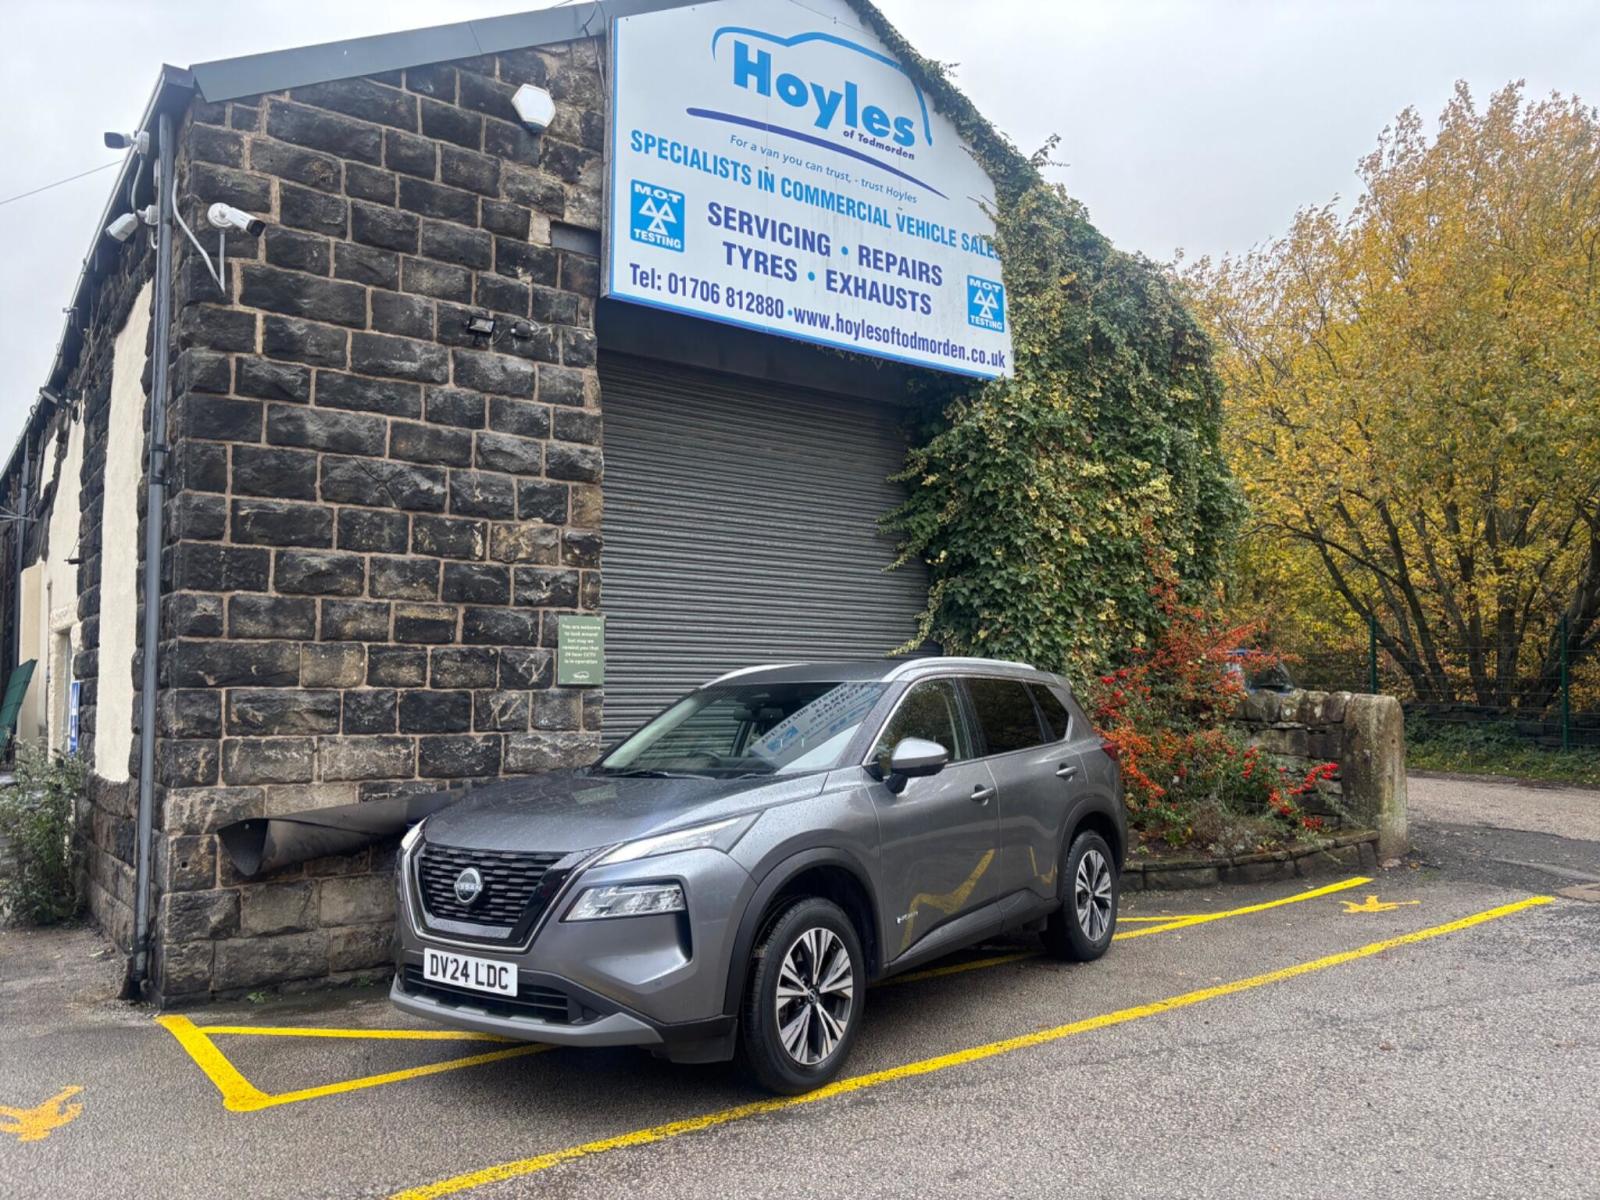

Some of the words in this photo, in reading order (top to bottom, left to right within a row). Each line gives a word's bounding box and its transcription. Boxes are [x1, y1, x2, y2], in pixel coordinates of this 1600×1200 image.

[734, 40, 915, 147] Hoyles
[730, 134, 748, 148] For
[750, 143, 757, 152] a
[760, 146, 780, 159] van
[782, 153, 803, 166] you
[805, 161, 823, 173] can
[825, 166, 851, 183] trust,
[861, 178, 884, 192] trust
[886, 186, 918, 204] Hoyles
[843, 130, 855, 139] of
[858, 133, 915, 160] Todmorden
[630, 129, 752, 186] SPECIALISTS
[758, 168, 775, 193] IN
[781, 177, 892, 229] COMMERCIAL
[896, 212, 957, 248] VEHICLE
[633, 228, 682, 249] TESTING
[707, 201, 831, 257] SERVICING
[858, 244, 943, 287] REPAIRS
[722, 241, 798, 283] TYRES
[826, 269, 932, 316] EXHAUSTS
[629, 262, 661, 292] Tel:
[668, 272, 720, 305] 01706
[726, 286, 784, 319] 812880
[794, 307, 1006, 368] www.hoylesoftodmorden.co.uk
[970, 314, 1003, 330] TESTING
[430, 953, 470, 983] DV24
[475, 962, 509, 990] LDC
